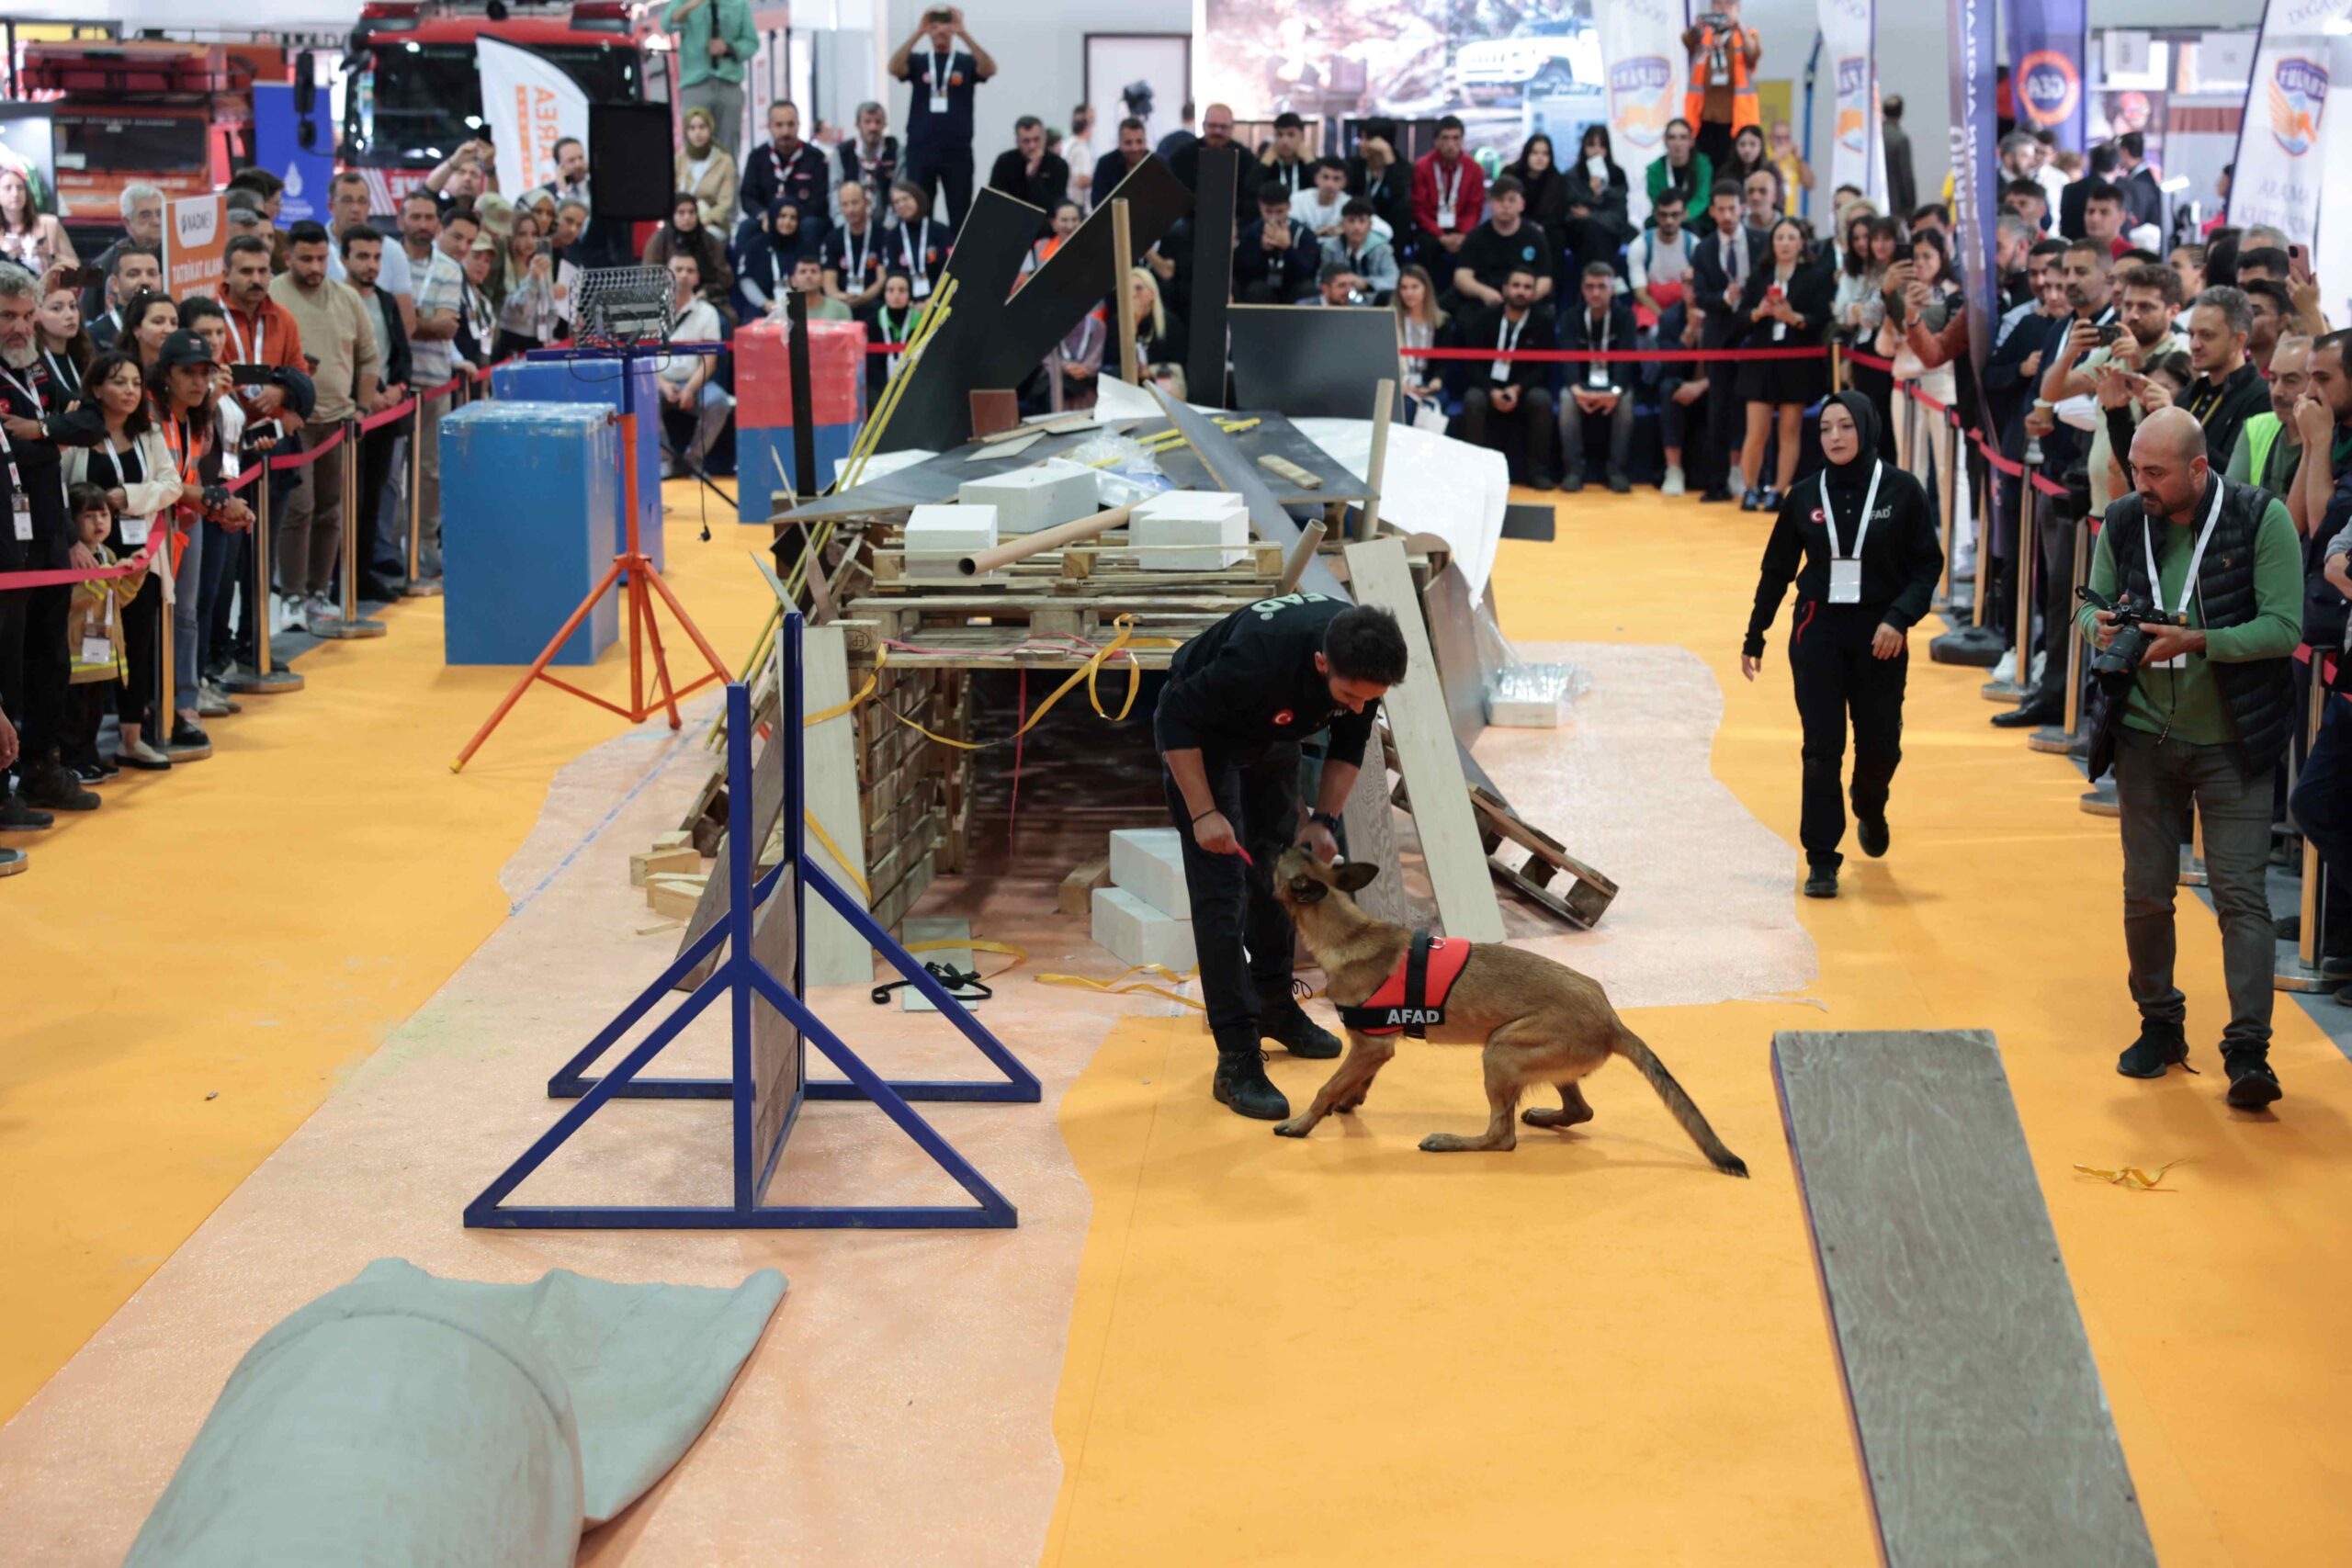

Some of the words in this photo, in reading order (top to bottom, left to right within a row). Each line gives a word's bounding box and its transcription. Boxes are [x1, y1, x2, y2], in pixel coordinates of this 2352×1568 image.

[1870, 508, 1891, 521] FAD
[1251, 592, 1329, 614] FAD
[1386, 1009, 1440, 1024] AFAD
